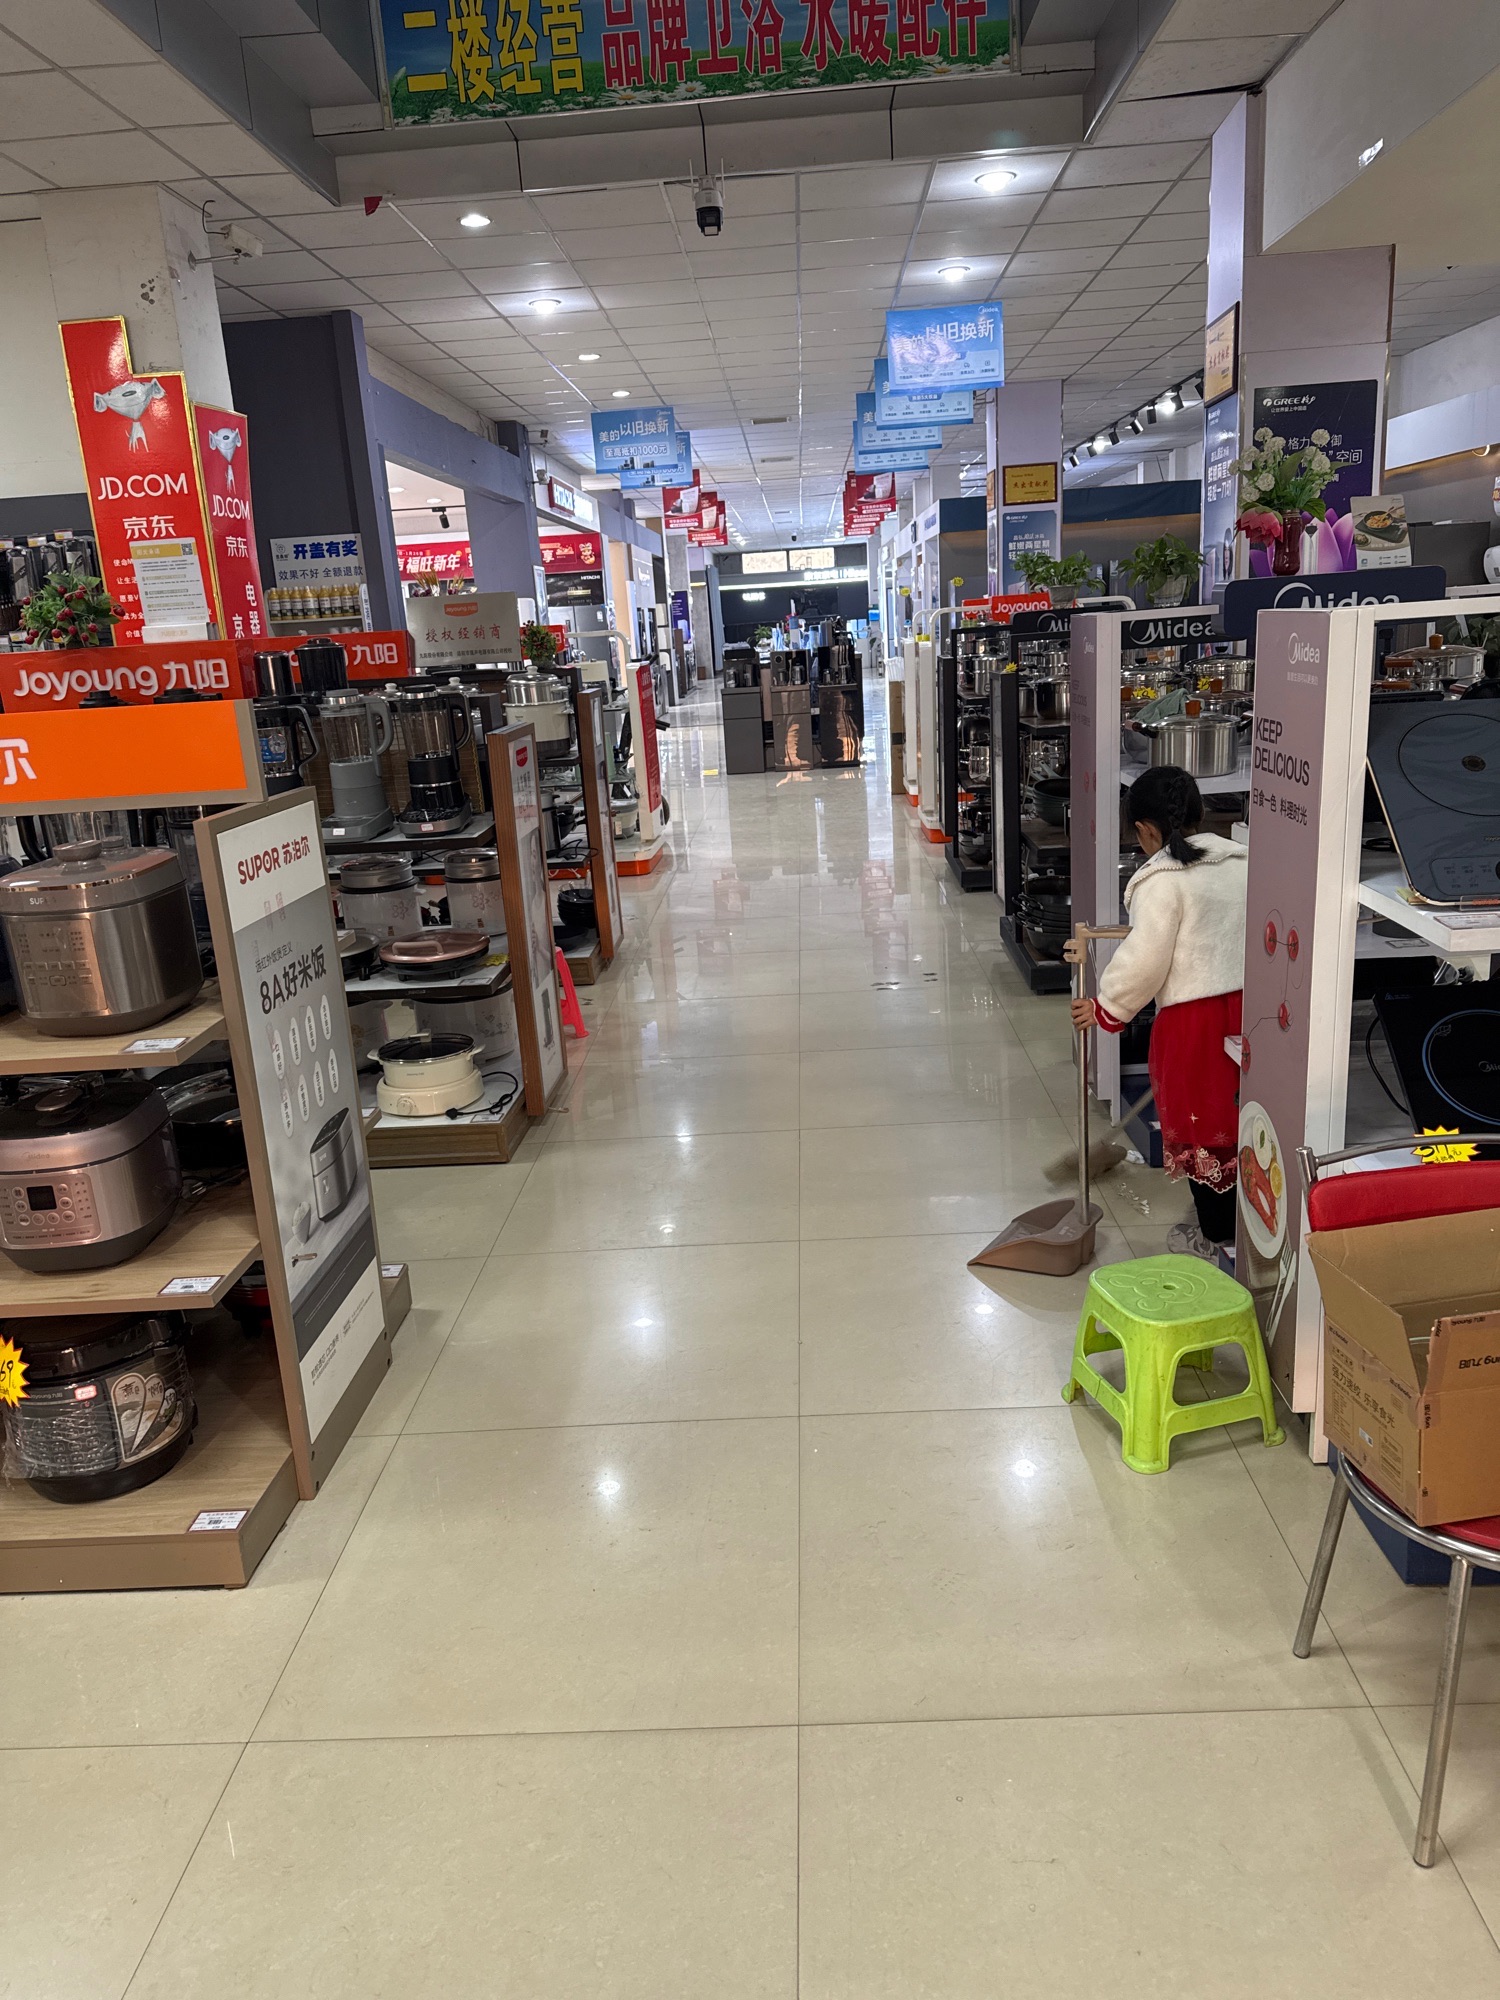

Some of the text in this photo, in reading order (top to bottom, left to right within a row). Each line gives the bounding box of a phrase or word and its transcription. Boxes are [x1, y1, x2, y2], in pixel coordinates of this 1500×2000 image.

[403, 0, 984, 103] 二楼经营 品牌卫浴 水暖配件
[1273, 397, 1301, 405] GREE
[599, 419, 669, 443] 美的以旧换新
[605, 445, 667, 457] 至高抵扣1000元
[98, 473, 188, 500] JD.COM
[213, 495, 250, 520] JD.COM
[122, 515, 177, 539] 京东
[225, 536, 249, 558] 京东
[293, 540, 358, 560] 开盖有奖
[278, 566, 363, 580] 效果不好 全额退款
[245, 582, 260, 635] 电器
[426, 624, 501, 643] 授权经销商
[1130, 620, 1214, 645] Midea
[351, 642, 398, 666] 九阳
[1288, 632, 1320, 664] Midea
[13, 658, 230, 701] Joyoung 九阳
[1256, 716, 1283, 745] KEEP
[1254, 746, 1310, 786] DELICIOUS
[1280, 797, 1308, 826] 料理时光
[237, 836, 311, 885] SUPOR 苏泊尔
[260, 944, 327, 1014] 8A好米饭
